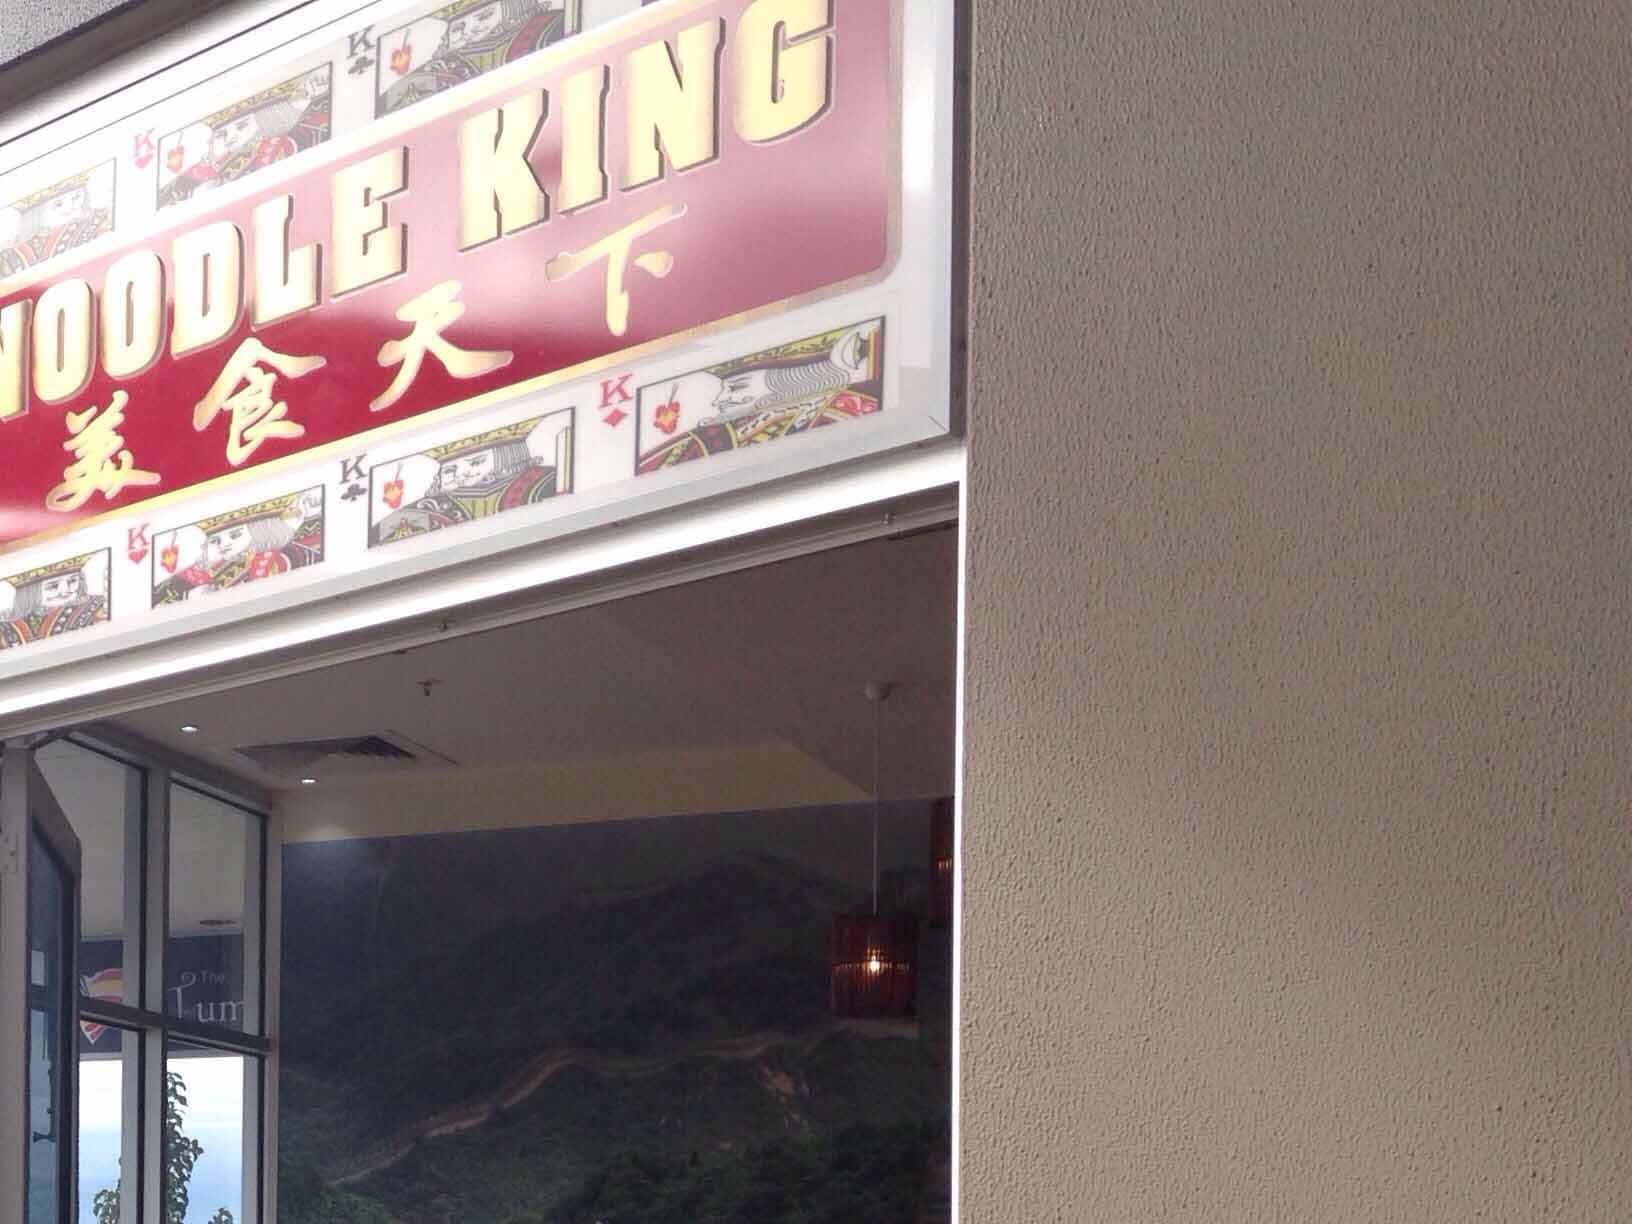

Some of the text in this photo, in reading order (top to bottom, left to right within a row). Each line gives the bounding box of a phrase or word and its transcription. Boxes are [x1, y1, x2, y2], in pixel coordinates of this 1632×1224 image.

[347, 24, 376, 58] K
[457, 0, 835, 253] KING
[45, 204, 688, 512] 美食天下
[600, 372, 634, 408] K
[128, 523, 150, 551] K
[340, 454, 368, 486] K
